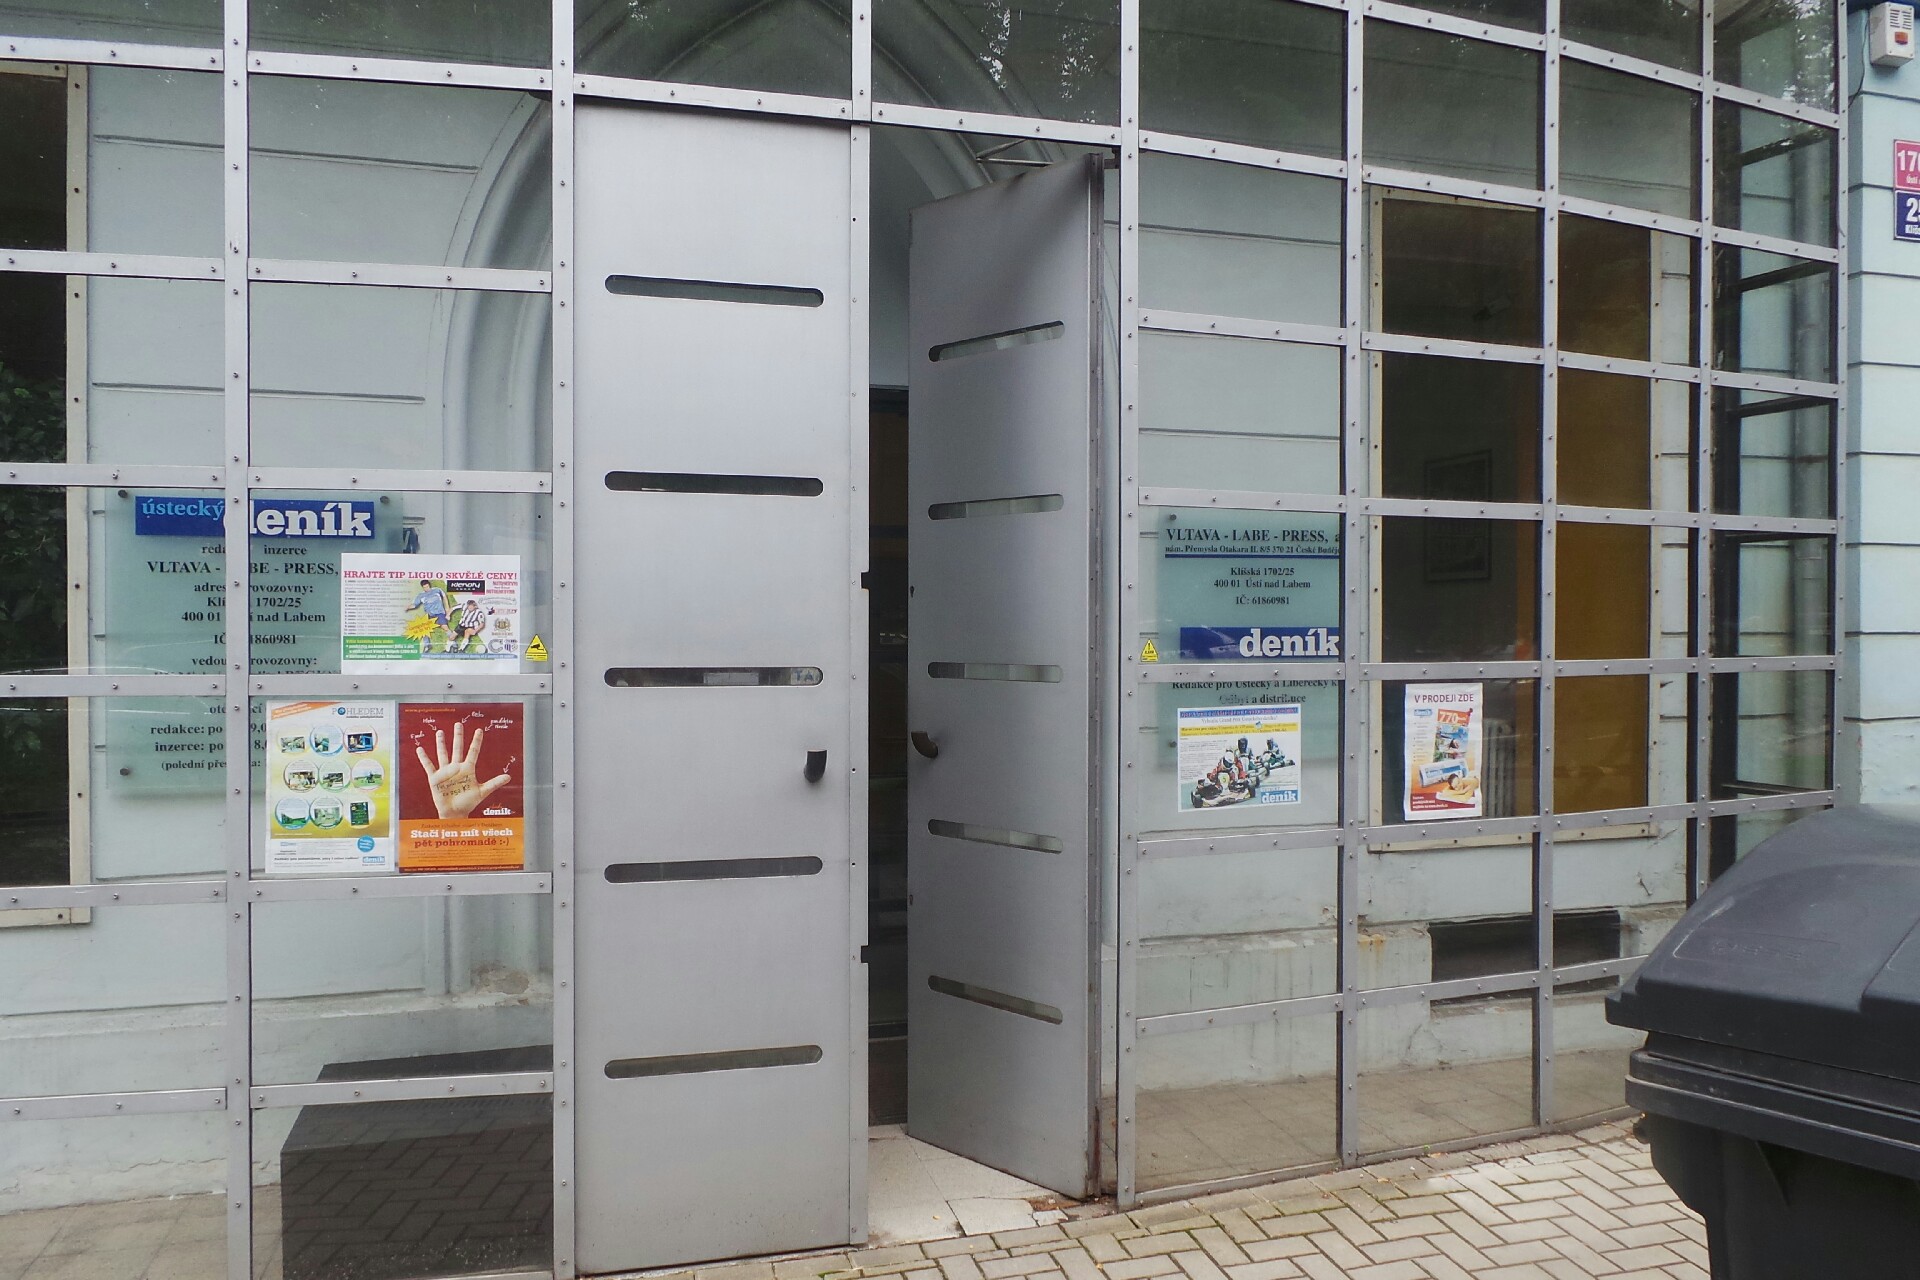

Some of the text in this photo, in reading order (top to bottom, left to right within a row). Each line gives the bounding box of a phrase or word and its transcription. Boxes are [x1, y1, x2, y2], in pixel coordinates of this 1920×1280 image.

[1897, 149, 1920, 172] 17
[142, 498, 225, 520] ústecký
[1166, 529, 1220, 541] VLTAVA
[1232, 529, 1270, 541] LABE
[1282, 529, 1328, 543] PRESS,
[263, 544, 307, 555] inzerce
[1185, 544, 1218, 554] Přemysla
[1219, 545, 1249, 553] Otakara
[147, 561, 211, 574] VLTAVA
[284, 562, 339, 576] PRESS,
[1230, 567, 1295, 576] Klíšská 1702/25
[343, 570, 385, 579] HRAJTE
[388, 571, 406, 579] TIP
[408, 571, 433, 579] LIGU
[446, 571, 484, 579] SKVĚLÉ
[486, 572, 517, 580] CENY!
[194, 582, 226, 592] adres
[1213, 578, 1311, 589] 400 01 Ústí nad Labem
[256, 597, 302, 608] 1702/25
[1235, 594, 1290, 605] IČ: 61860981
[181, 611, 204, 622] 400
[207, 611, 221, 622] 01
[257, 612, 279, 622] nad
[284, 612, 326, 622] Labem
[249, 634, 296, 645] 1860981
[1239, 628, 1340, 657] deník
[192, 656, 317, 667] vedou rovozovny:
[1414, 693, 1474, 703] V PRODEJI ZDE
[151, 724, 205, 735] redakce:
[207, 725, 223, 736] po
[155, 740, 204, 752] inzerce:
[209, 742, 224, 753] po
[161, 759, 204, 771] (polední
[1262, 790, 1297, 803] deník
[410, 828, 514, 839] Stačí jen mít všech
[414, 839, 433, 849] pět
